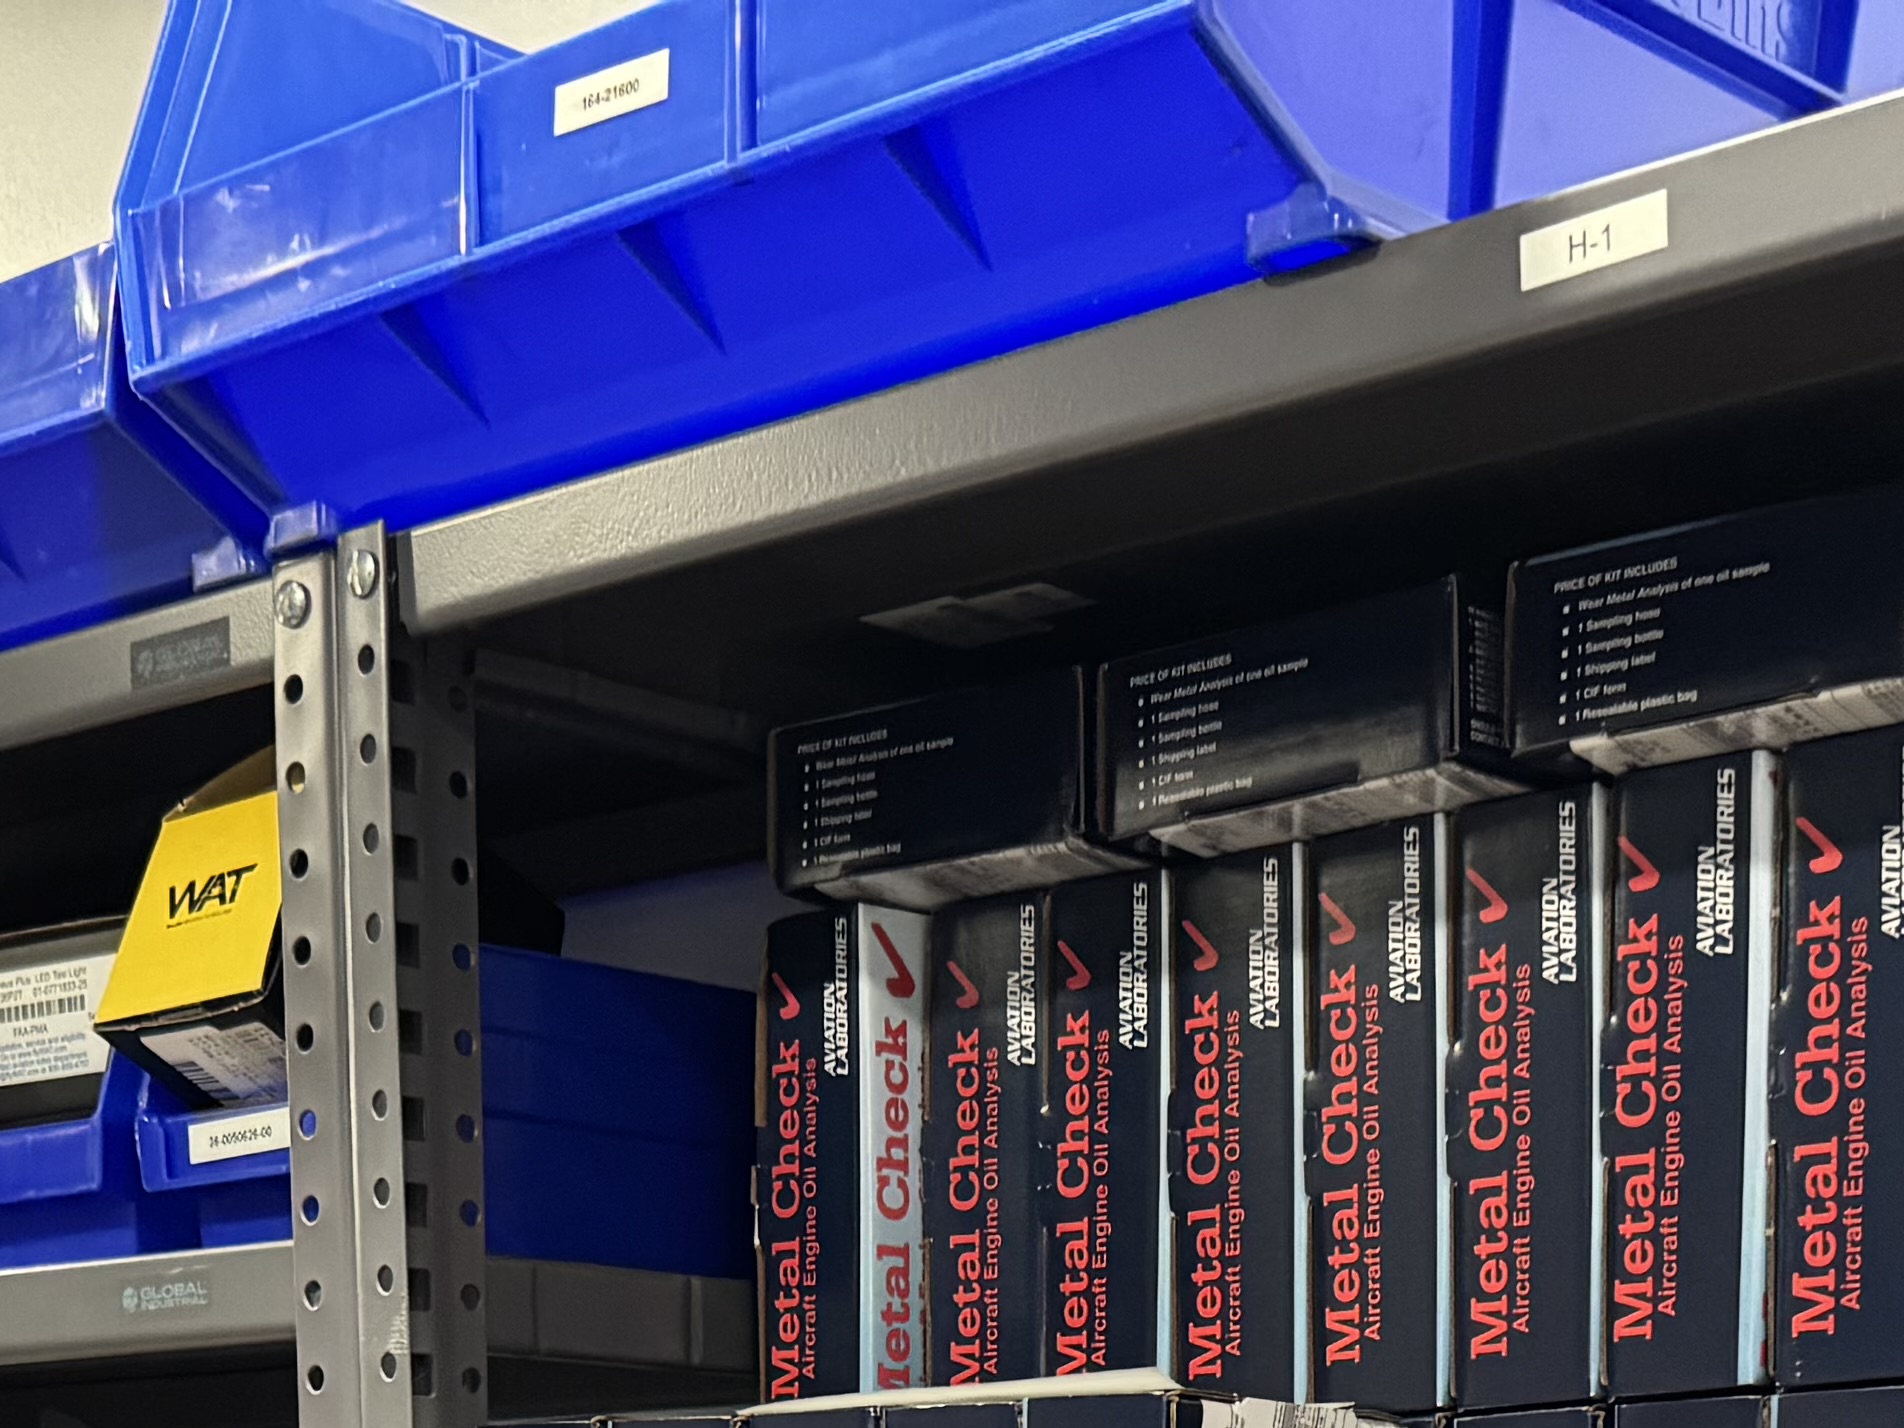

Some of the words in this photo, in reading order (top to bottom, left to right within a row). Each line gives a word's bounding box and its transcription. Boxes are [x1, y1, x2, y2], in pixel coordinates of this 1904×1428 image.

[1568, 225, 1613, 263] H-1
[168, 863, 258, 920] WAT
[1542, 878, 1559, 984] AVIATION
[1559, 800, 1577, 982] LABORATORIES
[1469, 945, 1509, 1152] Check
[1514, 966, 1535, 1078] Analysis
[1514, 1090, 1531, 1126] Oil
[1514, 1136, 1535, 1227] Engine
[140, 1281, 207, 1300] GLOBAL
[1470, 1172, 1509, 1359] Metal
[1514, 1239, 1530, 1333] Aircraft
